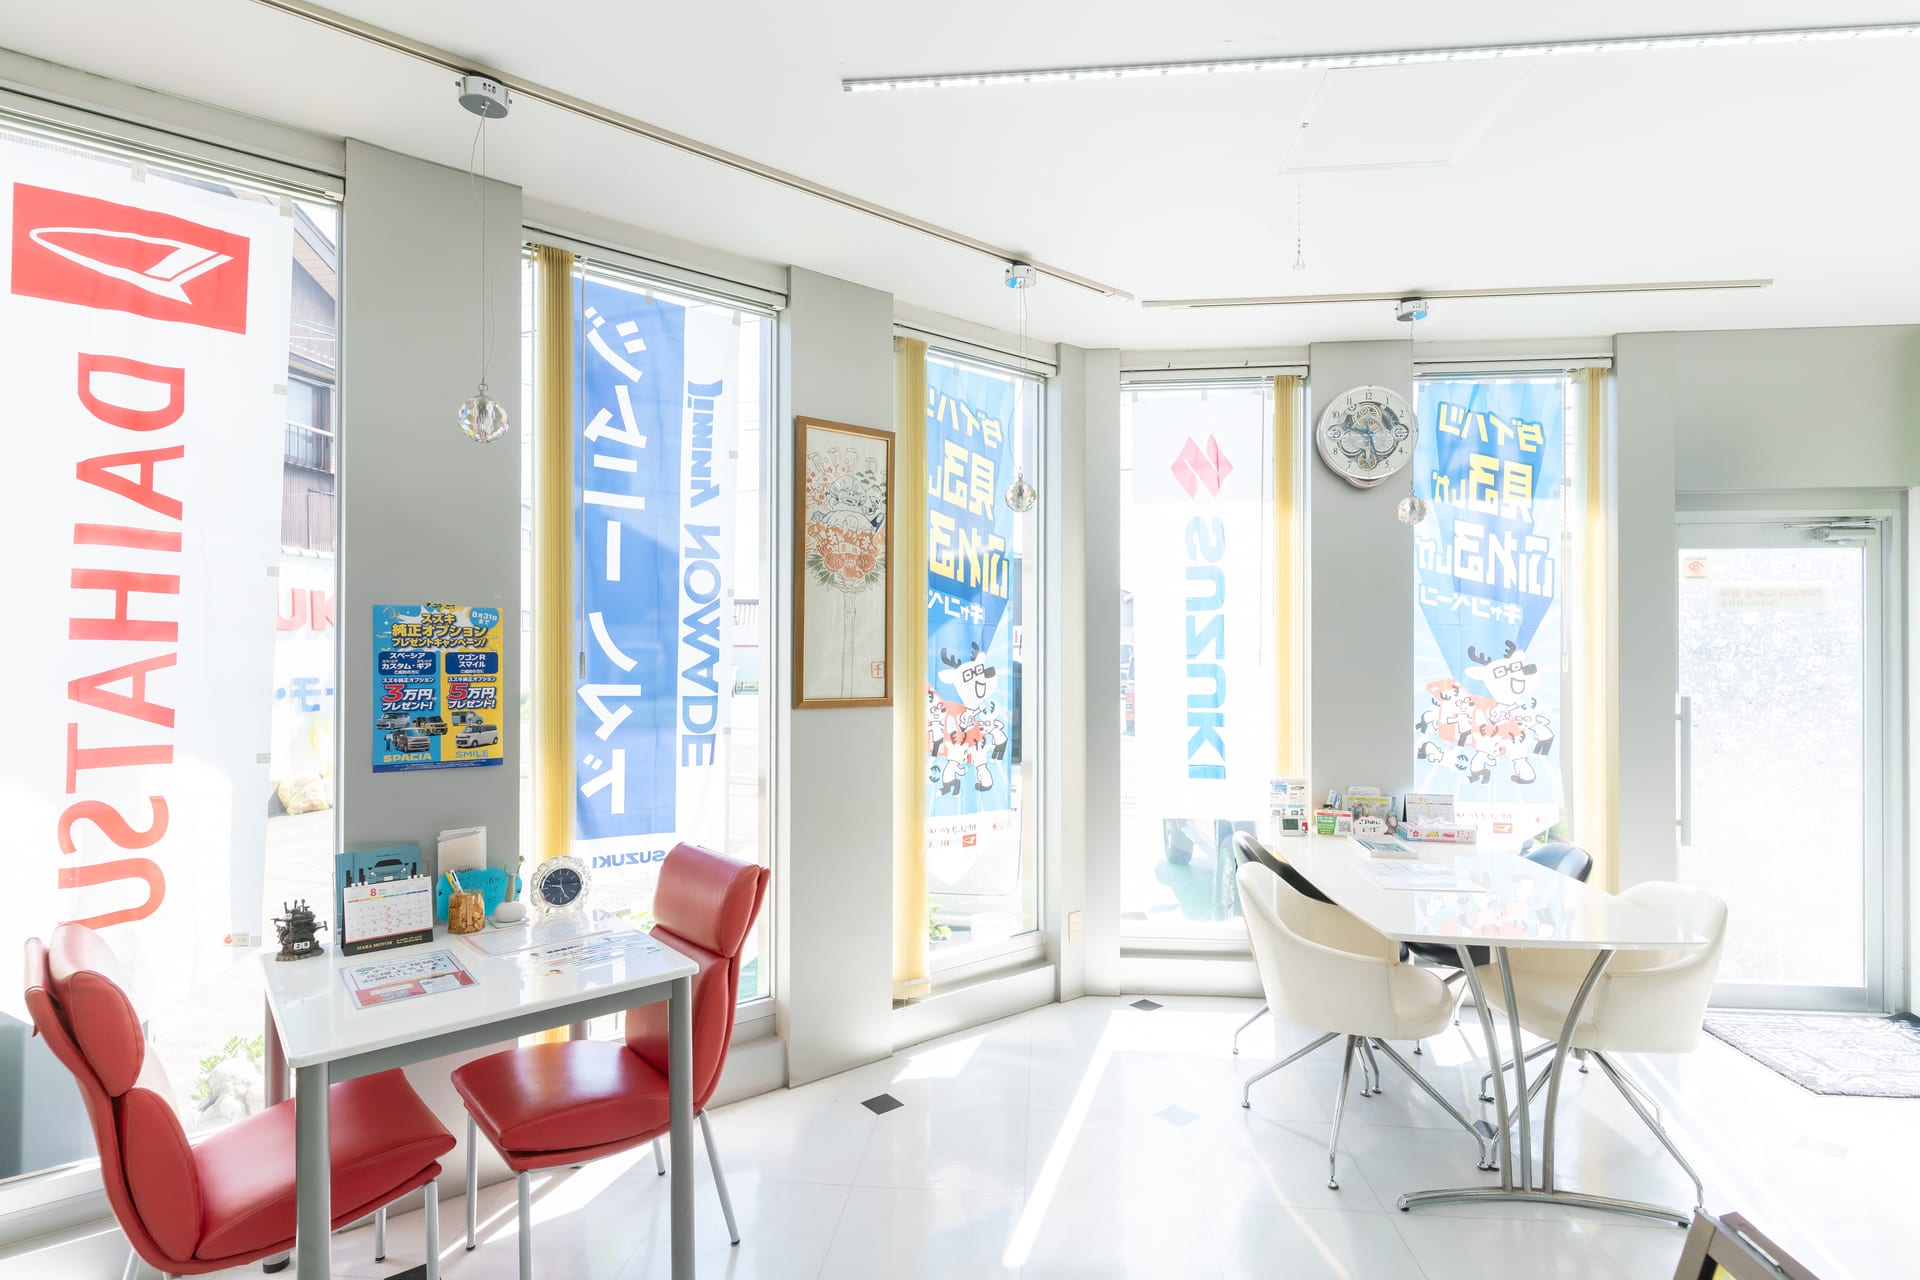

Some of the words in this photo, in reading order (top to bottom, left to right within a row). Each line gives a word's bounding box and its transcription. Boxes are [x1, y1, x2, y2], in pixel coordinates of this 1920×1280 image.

[421, 613, 456, 624] スズキ
[391, 624, 488, 638] 純正オプション
[458, 661, 486, 669] スマイル
[383, 752, 433, 763] SPACIA
[455, 750, 489, 758] SMILE
[370, 888, 377, 897] 8
